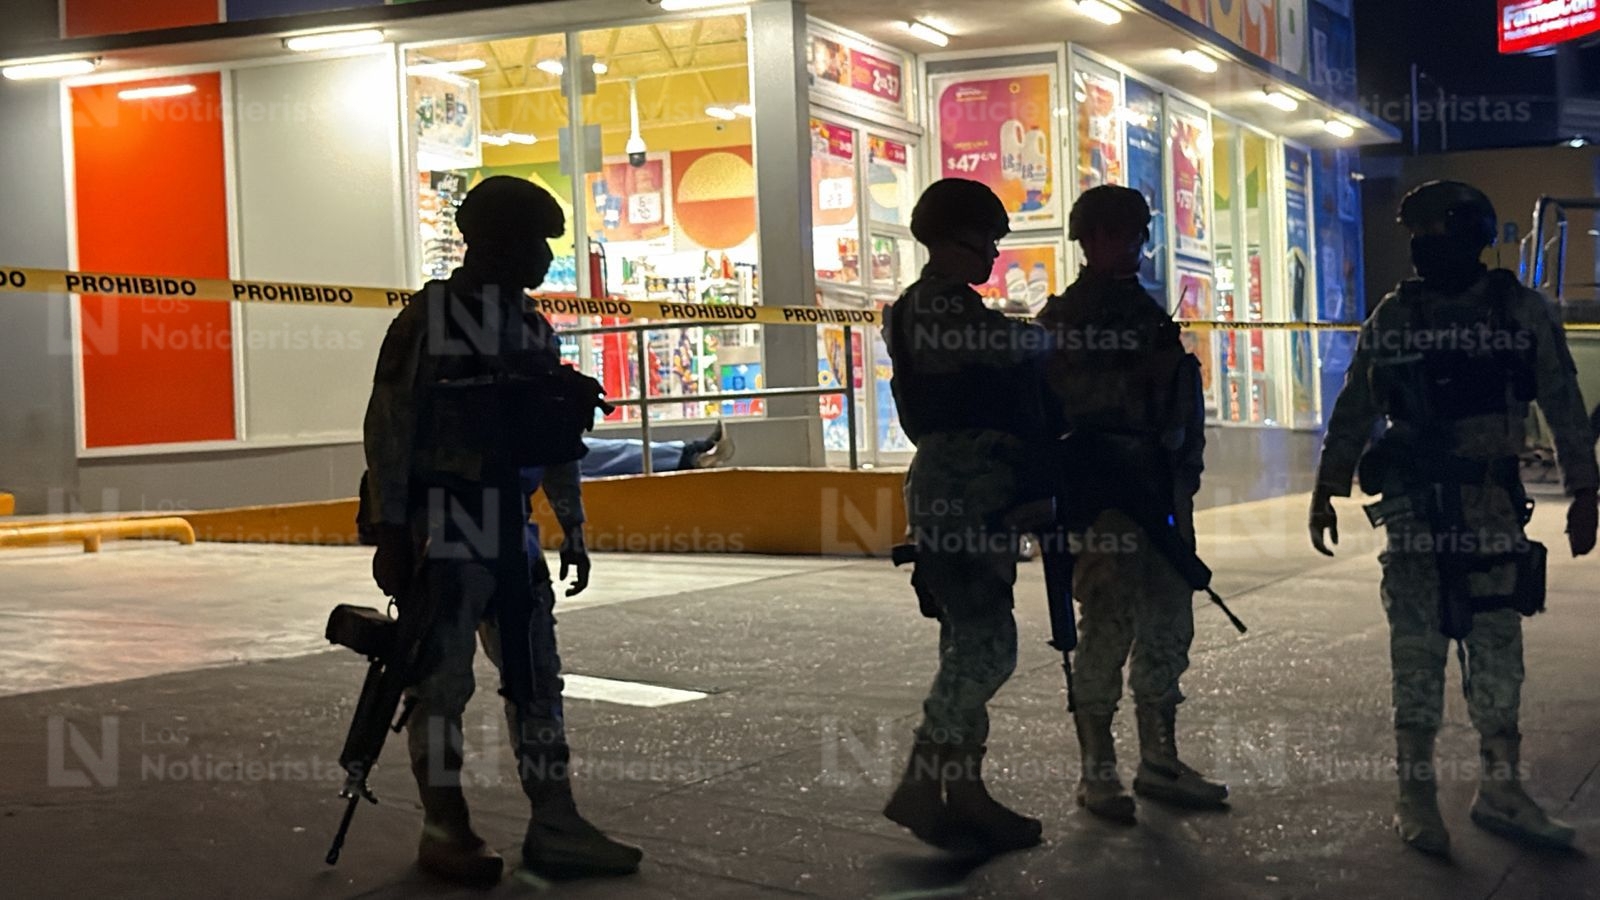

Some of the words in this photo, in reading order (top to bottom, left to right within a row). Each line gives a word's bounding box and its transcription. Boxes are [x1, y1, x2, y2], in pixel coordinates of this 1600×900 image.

[65, 275, 197, 296] PROHIBIDO
[232, 284, 353, 303] PROHIBIDO
[540, 300, 632, 315] ROHIBIDO
[660, 304, 757, 319] PROHIBIDO
[783, 308, 875, 323] PROHIBIDO
